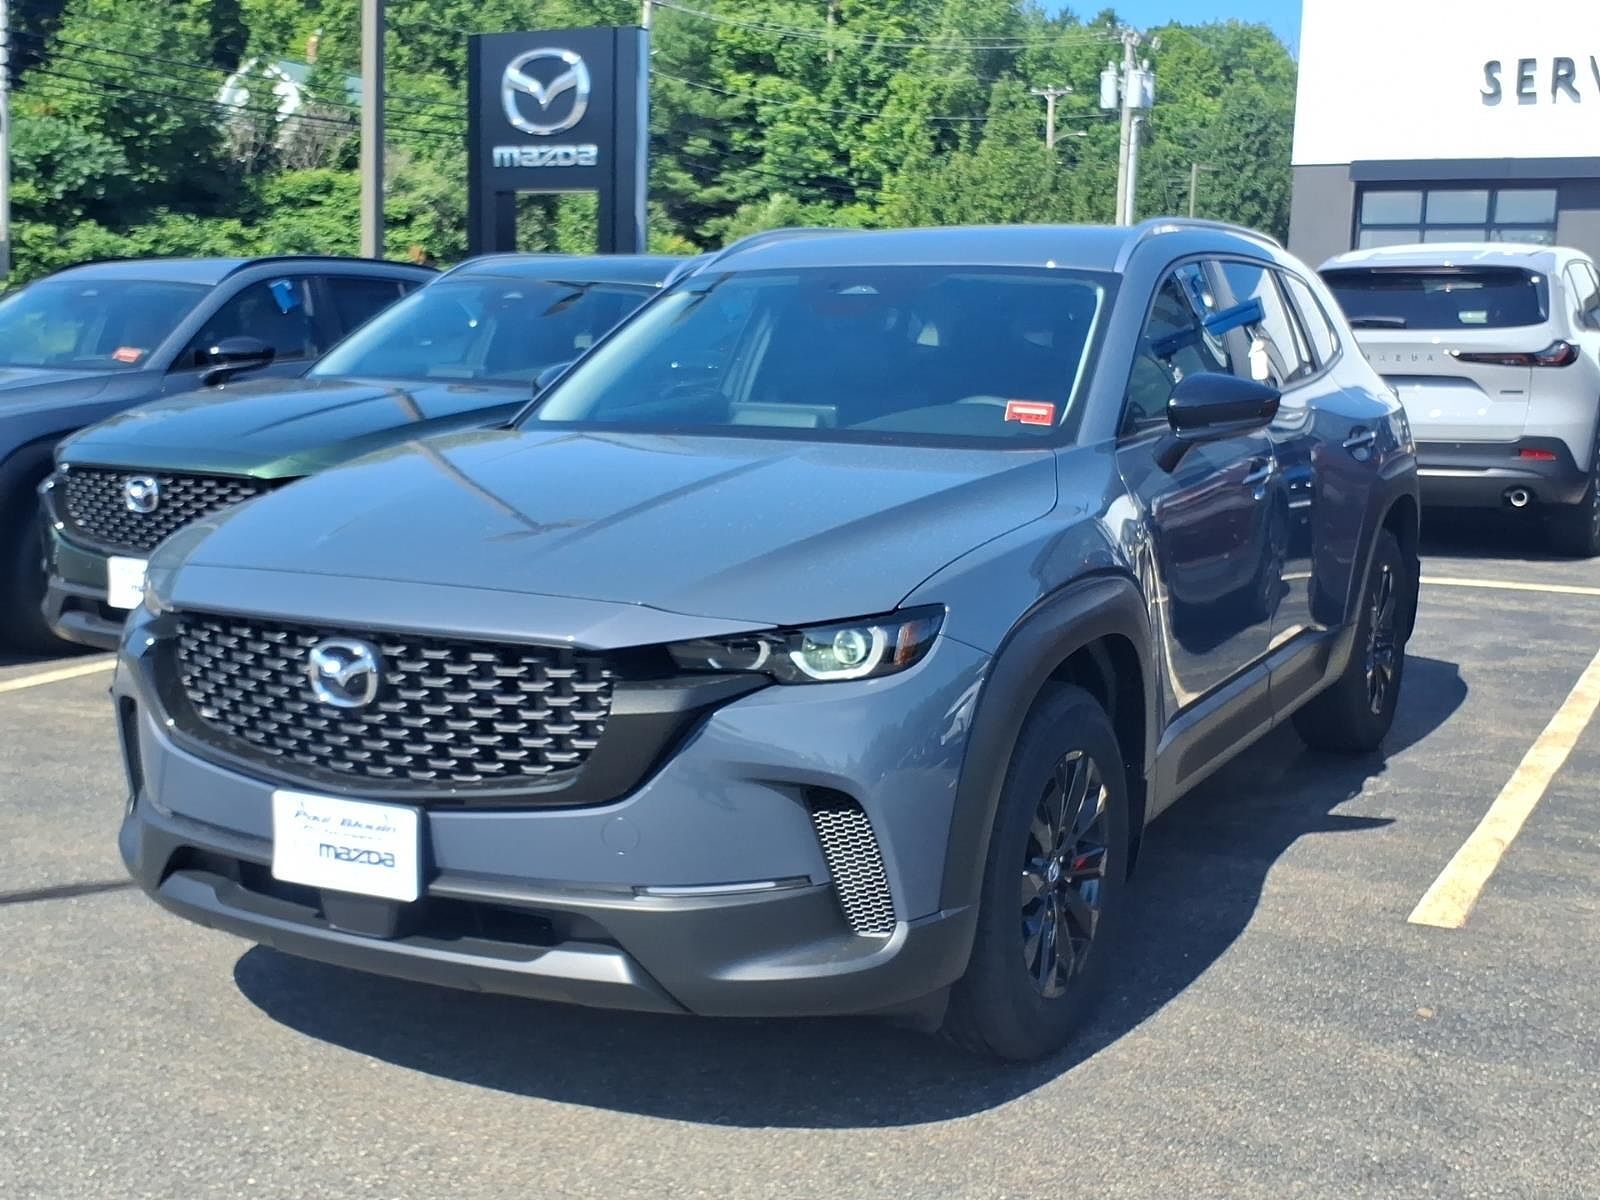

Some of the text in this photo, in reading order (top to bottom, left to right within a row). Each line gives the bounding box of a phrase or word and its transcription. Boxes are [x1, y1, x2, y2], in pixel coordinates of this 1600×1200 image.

[492, 143, 598, 168] mazda
[1366, 353, 1435, 362] AZDA
[319, 843, 395, 868] mazda
